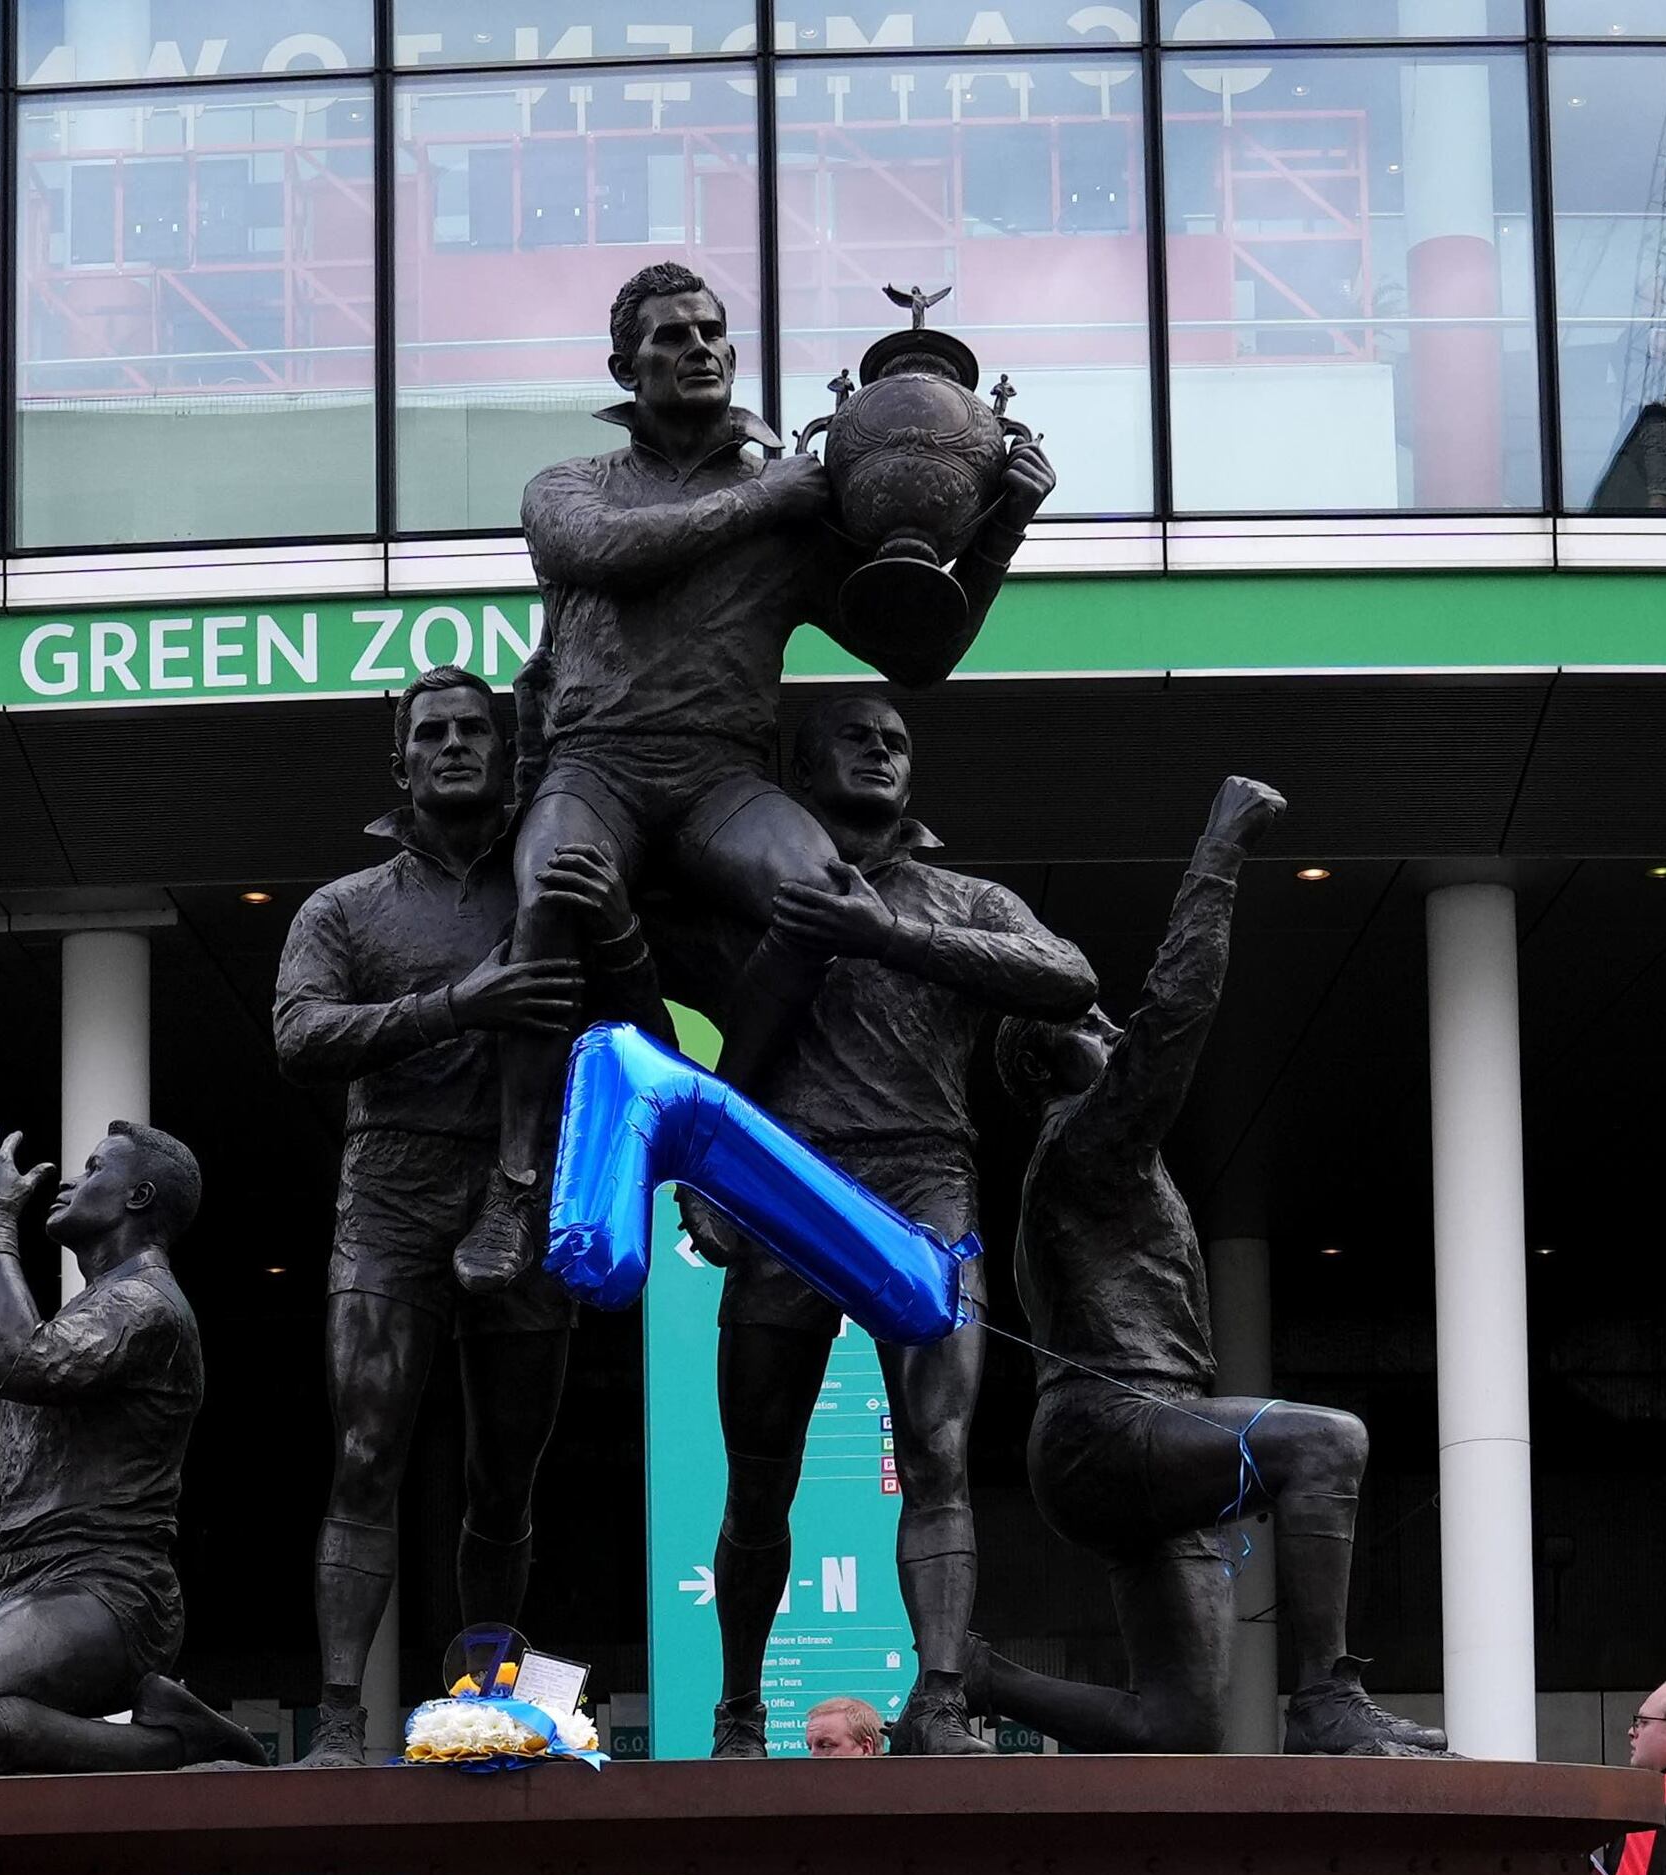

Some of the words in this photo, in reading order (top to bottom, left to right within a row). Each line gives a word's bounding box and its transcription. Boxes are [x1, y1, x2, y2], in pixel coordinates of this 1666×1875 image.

[19, 611, 317, 695] GREEN
[797, 1635, 833, 1646] Entrance
[779, 1657, 801, 1667] Store
[779, 1678, 802, 1688] Tours
[998, 1729, 1041, 1748] G.06
[784, 1741, 803, 1750] Park
